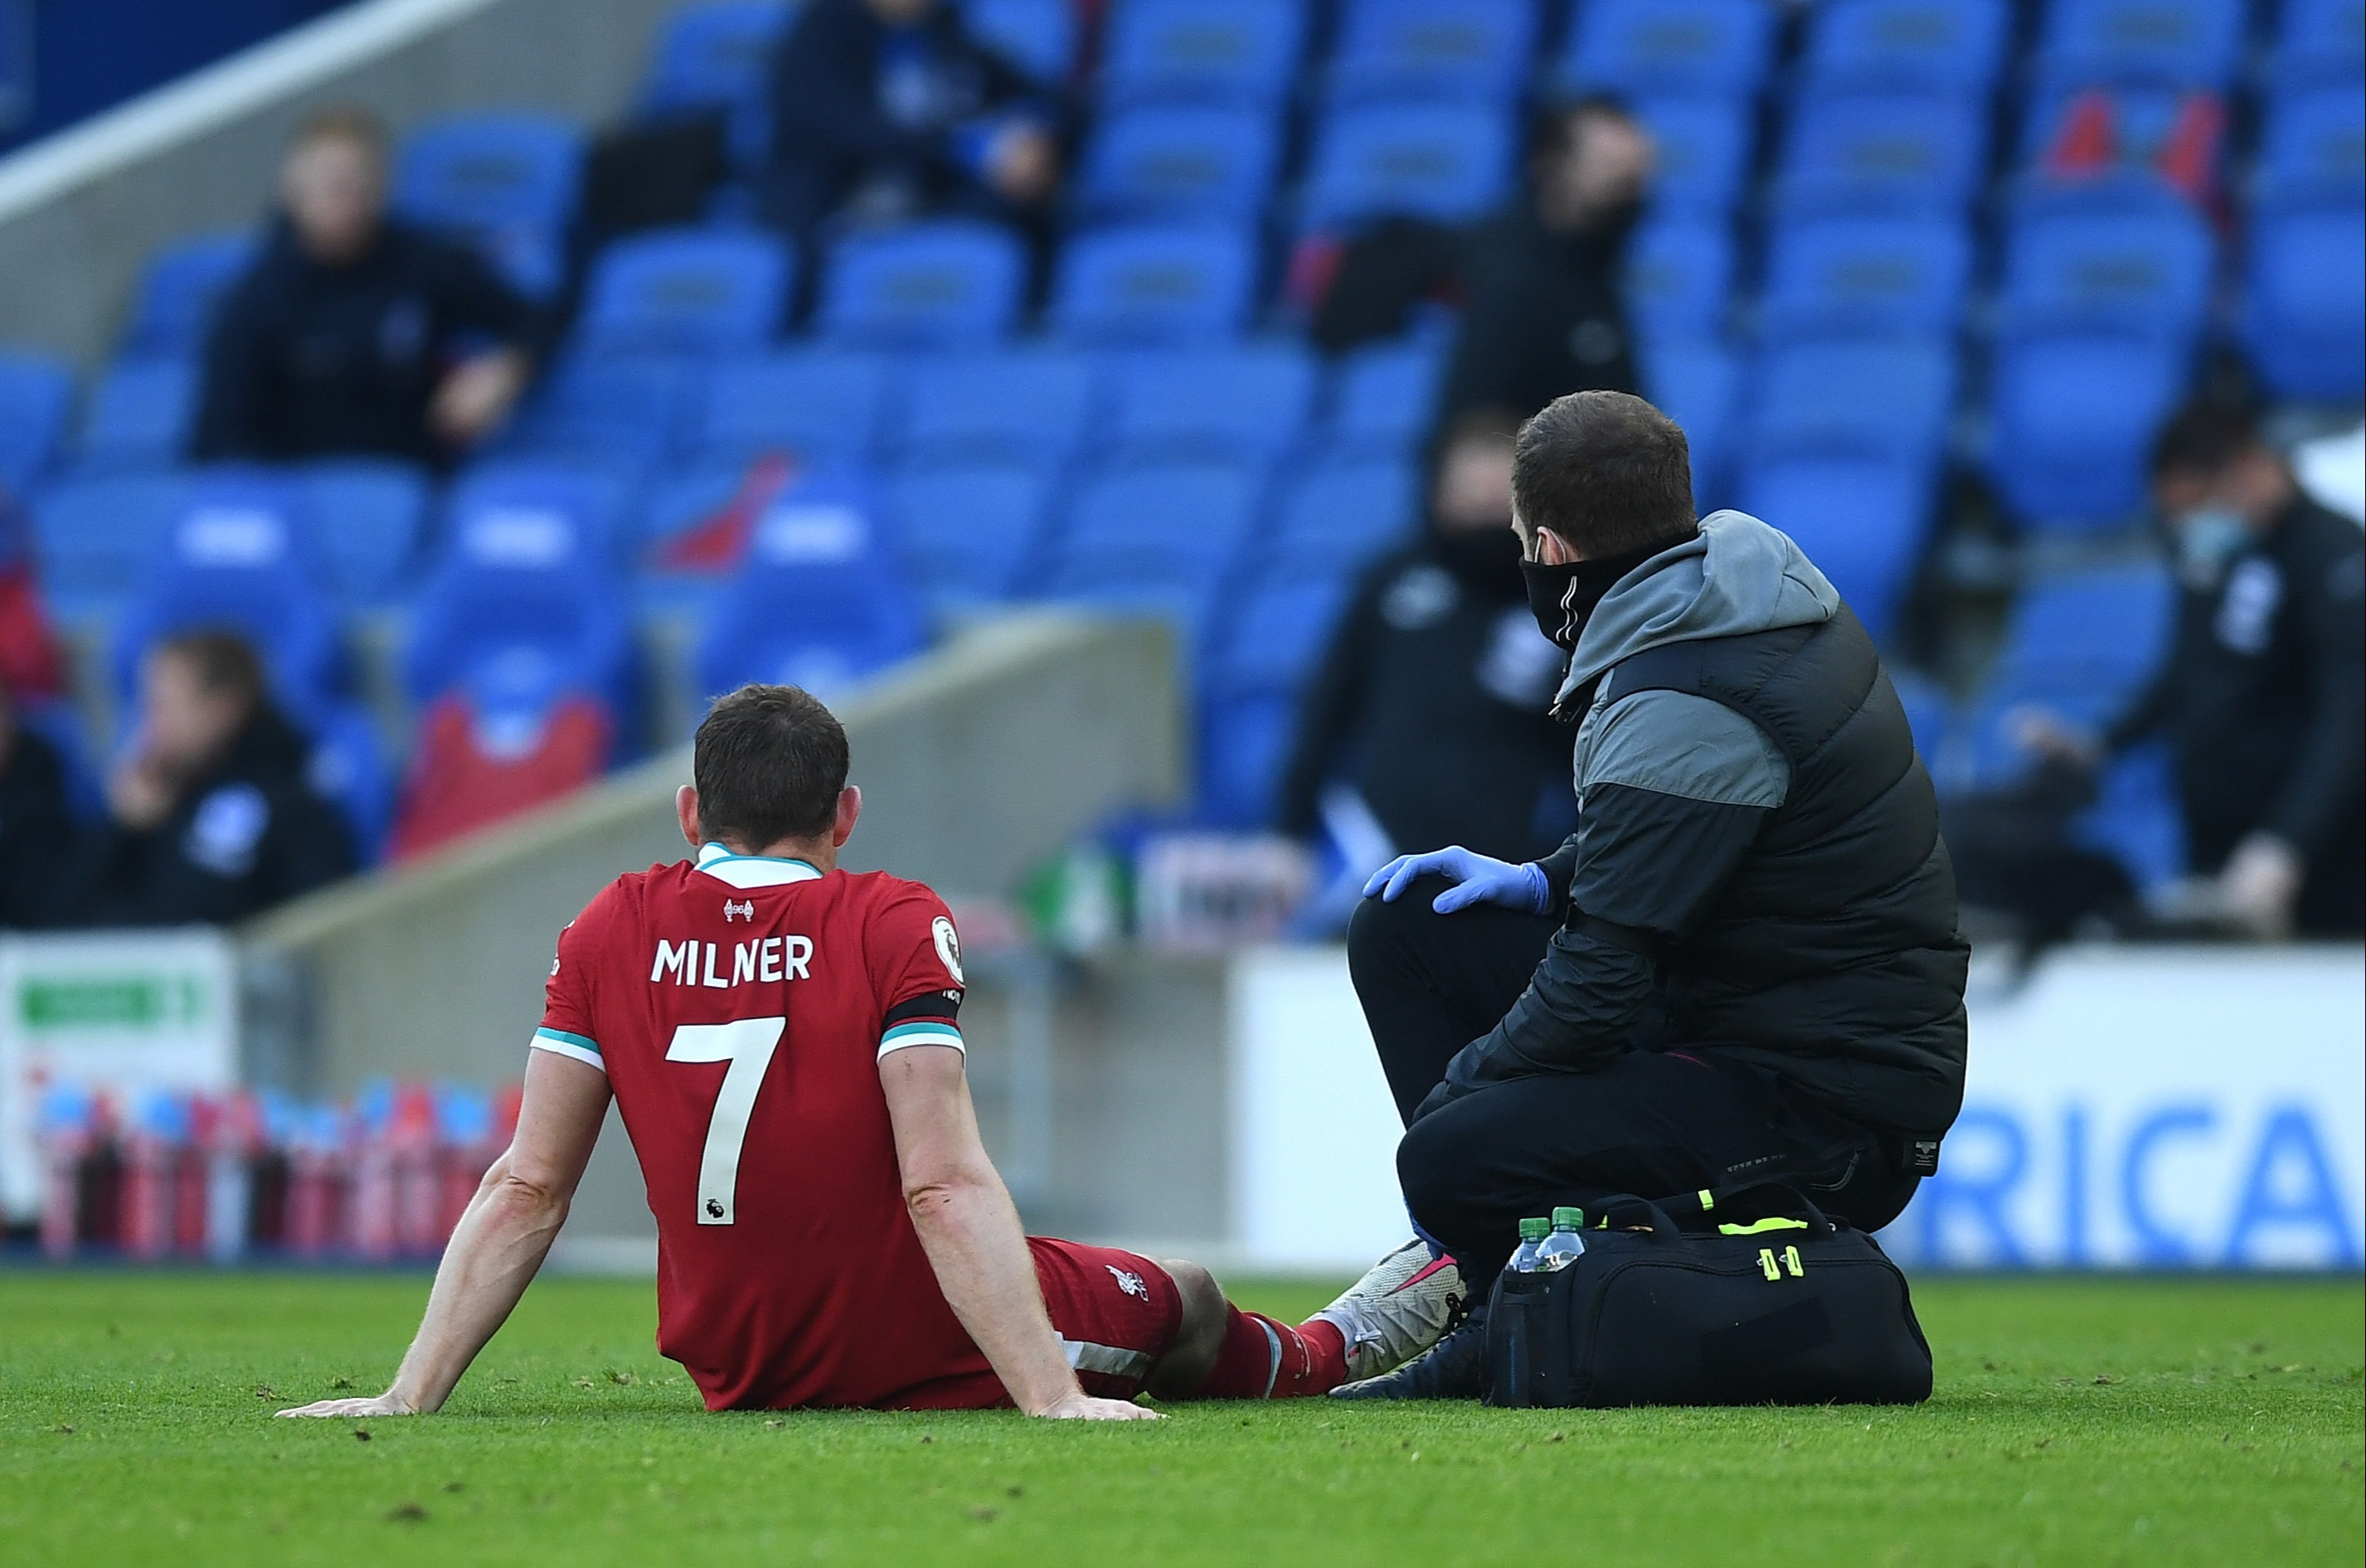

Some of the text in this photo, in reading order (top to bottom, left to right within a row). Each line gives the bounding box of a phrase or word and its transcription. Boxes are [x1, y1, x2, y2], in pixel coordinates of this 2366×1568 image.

[650, 934, 814, 988] MILNER
[732, 905, 744, 915] 96
[664, 1016, 787, 1226] 7
[1916, 1101, 2363, 1269] RICA
